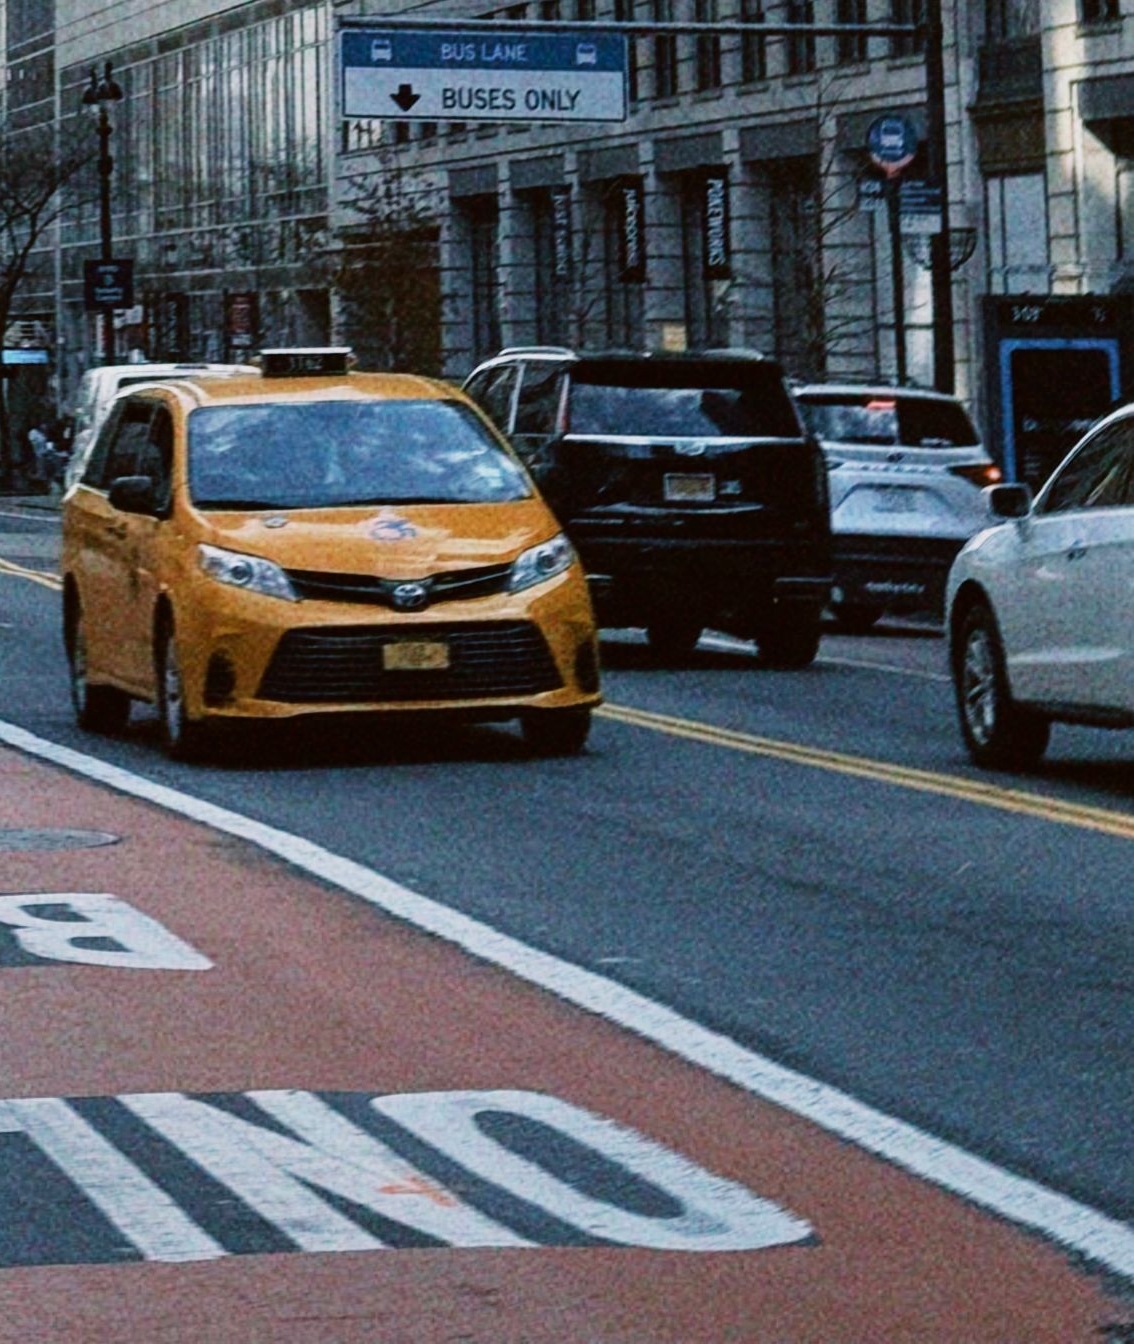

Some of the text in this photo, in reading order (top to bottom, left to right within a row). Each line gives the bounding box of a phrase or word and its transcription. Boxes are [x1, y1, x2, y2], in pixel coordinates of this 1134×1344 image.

[441, 43, 528, 62] BUS LANE
[442, 87, 582, 112] BUSES ONLY
